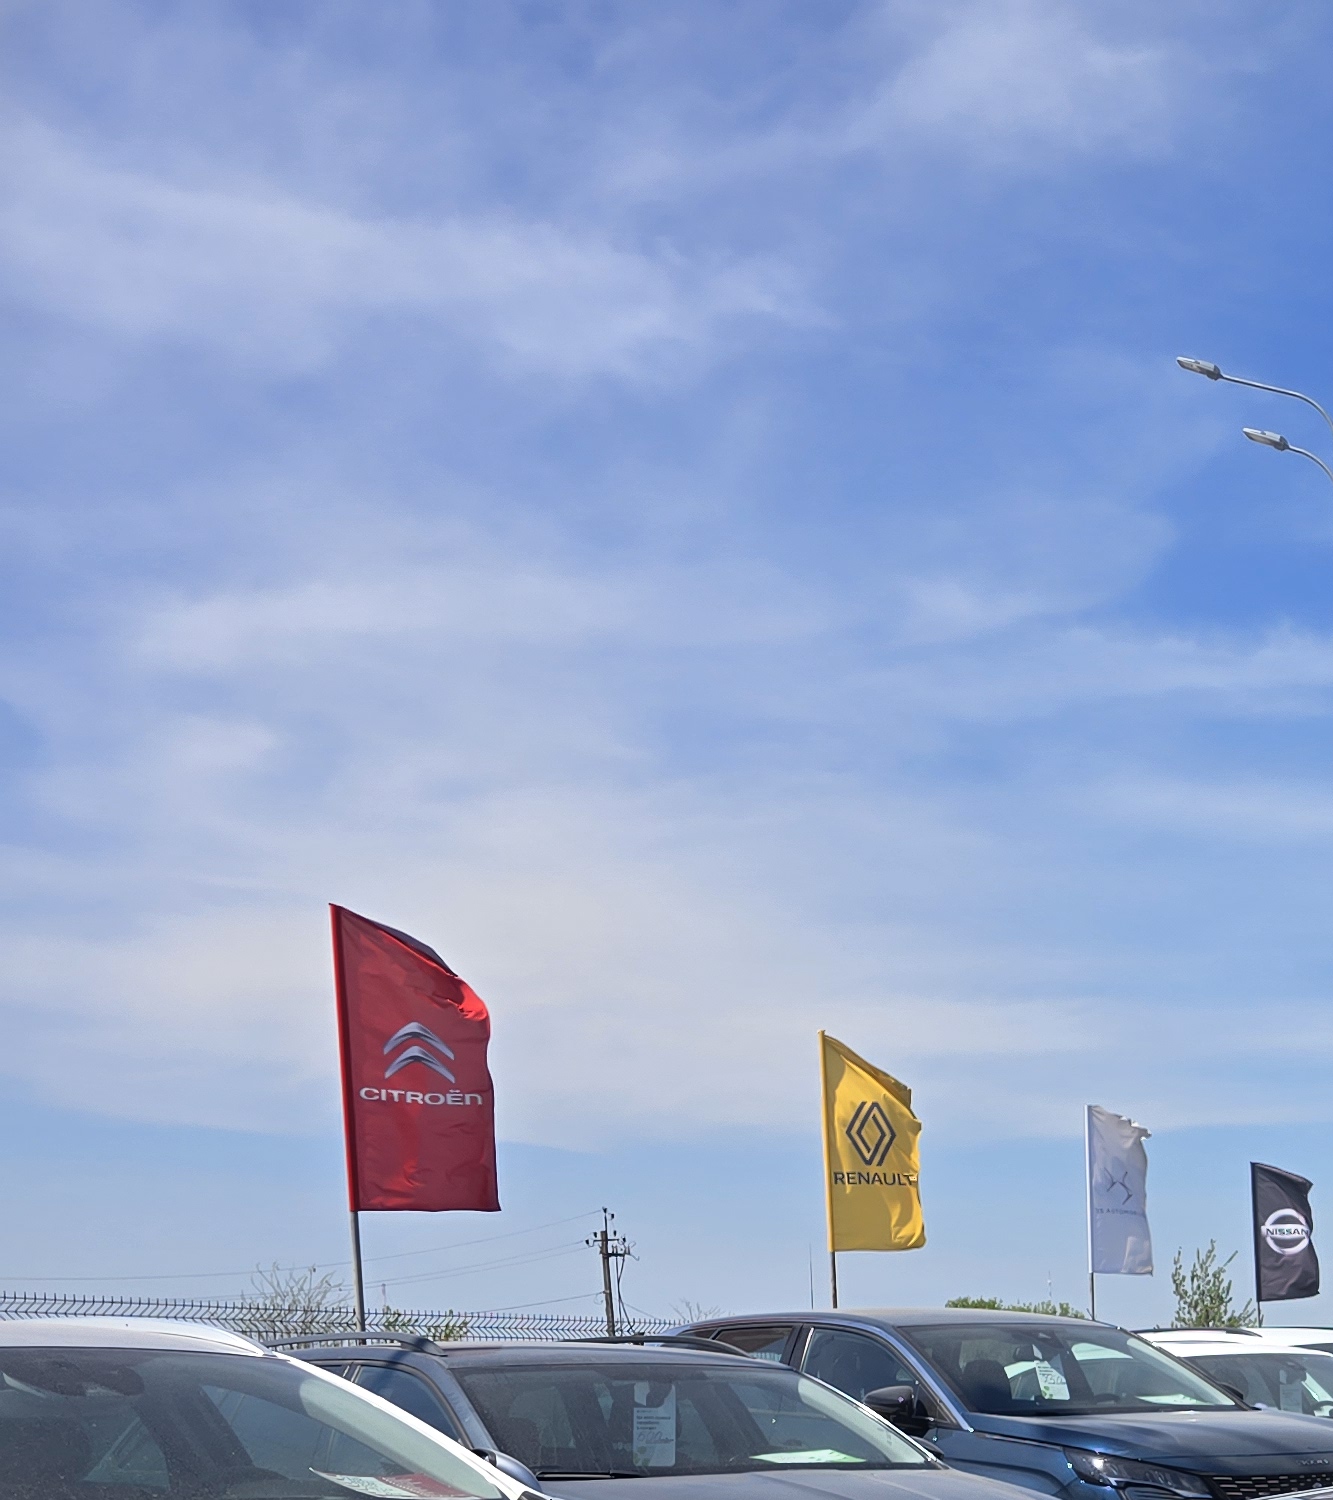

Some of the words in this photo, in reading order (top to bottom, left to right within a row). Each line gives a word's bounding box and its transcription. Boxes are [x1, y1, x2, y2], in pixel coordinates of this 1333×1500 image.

[359, 1086, 484, 1107] CITROËN
[833, 1171, 915, 1186] RENAULT
[1266, 1228, 1309, 1236] NISSAN
